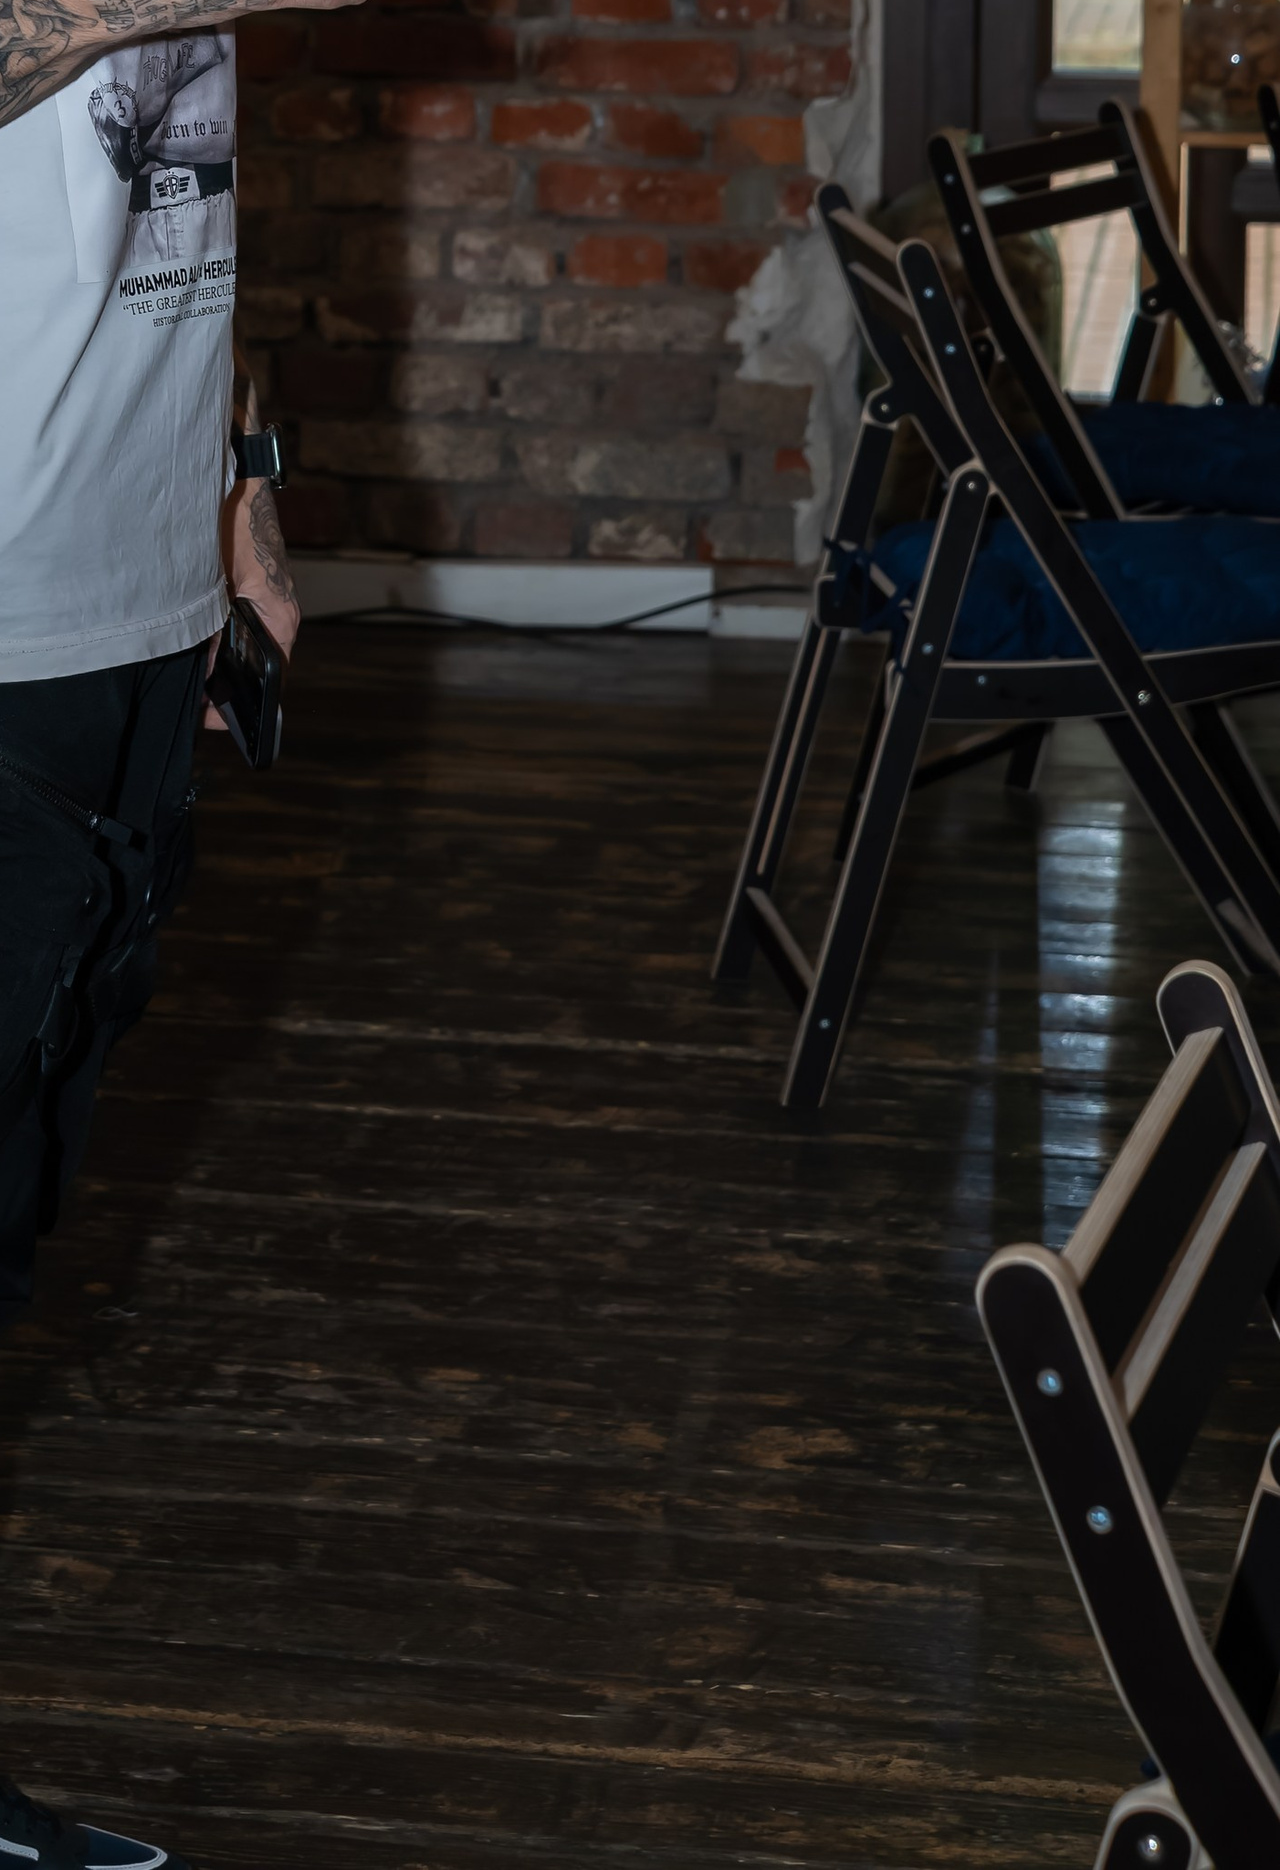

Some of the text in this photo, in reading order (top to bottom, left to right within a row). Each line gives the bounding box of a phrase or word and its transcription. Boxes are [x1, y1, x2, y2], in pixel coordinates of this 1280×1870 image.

[113, 99, 126, 119] 3
[194, 119, 207, 137] to
[209, 116, 228, 135] win
[119, 267, 187, 298] MUHAMMAD
[156, 289, 197, 311] GREATEST
[184, 302, 231, 320] COLLABORATION
